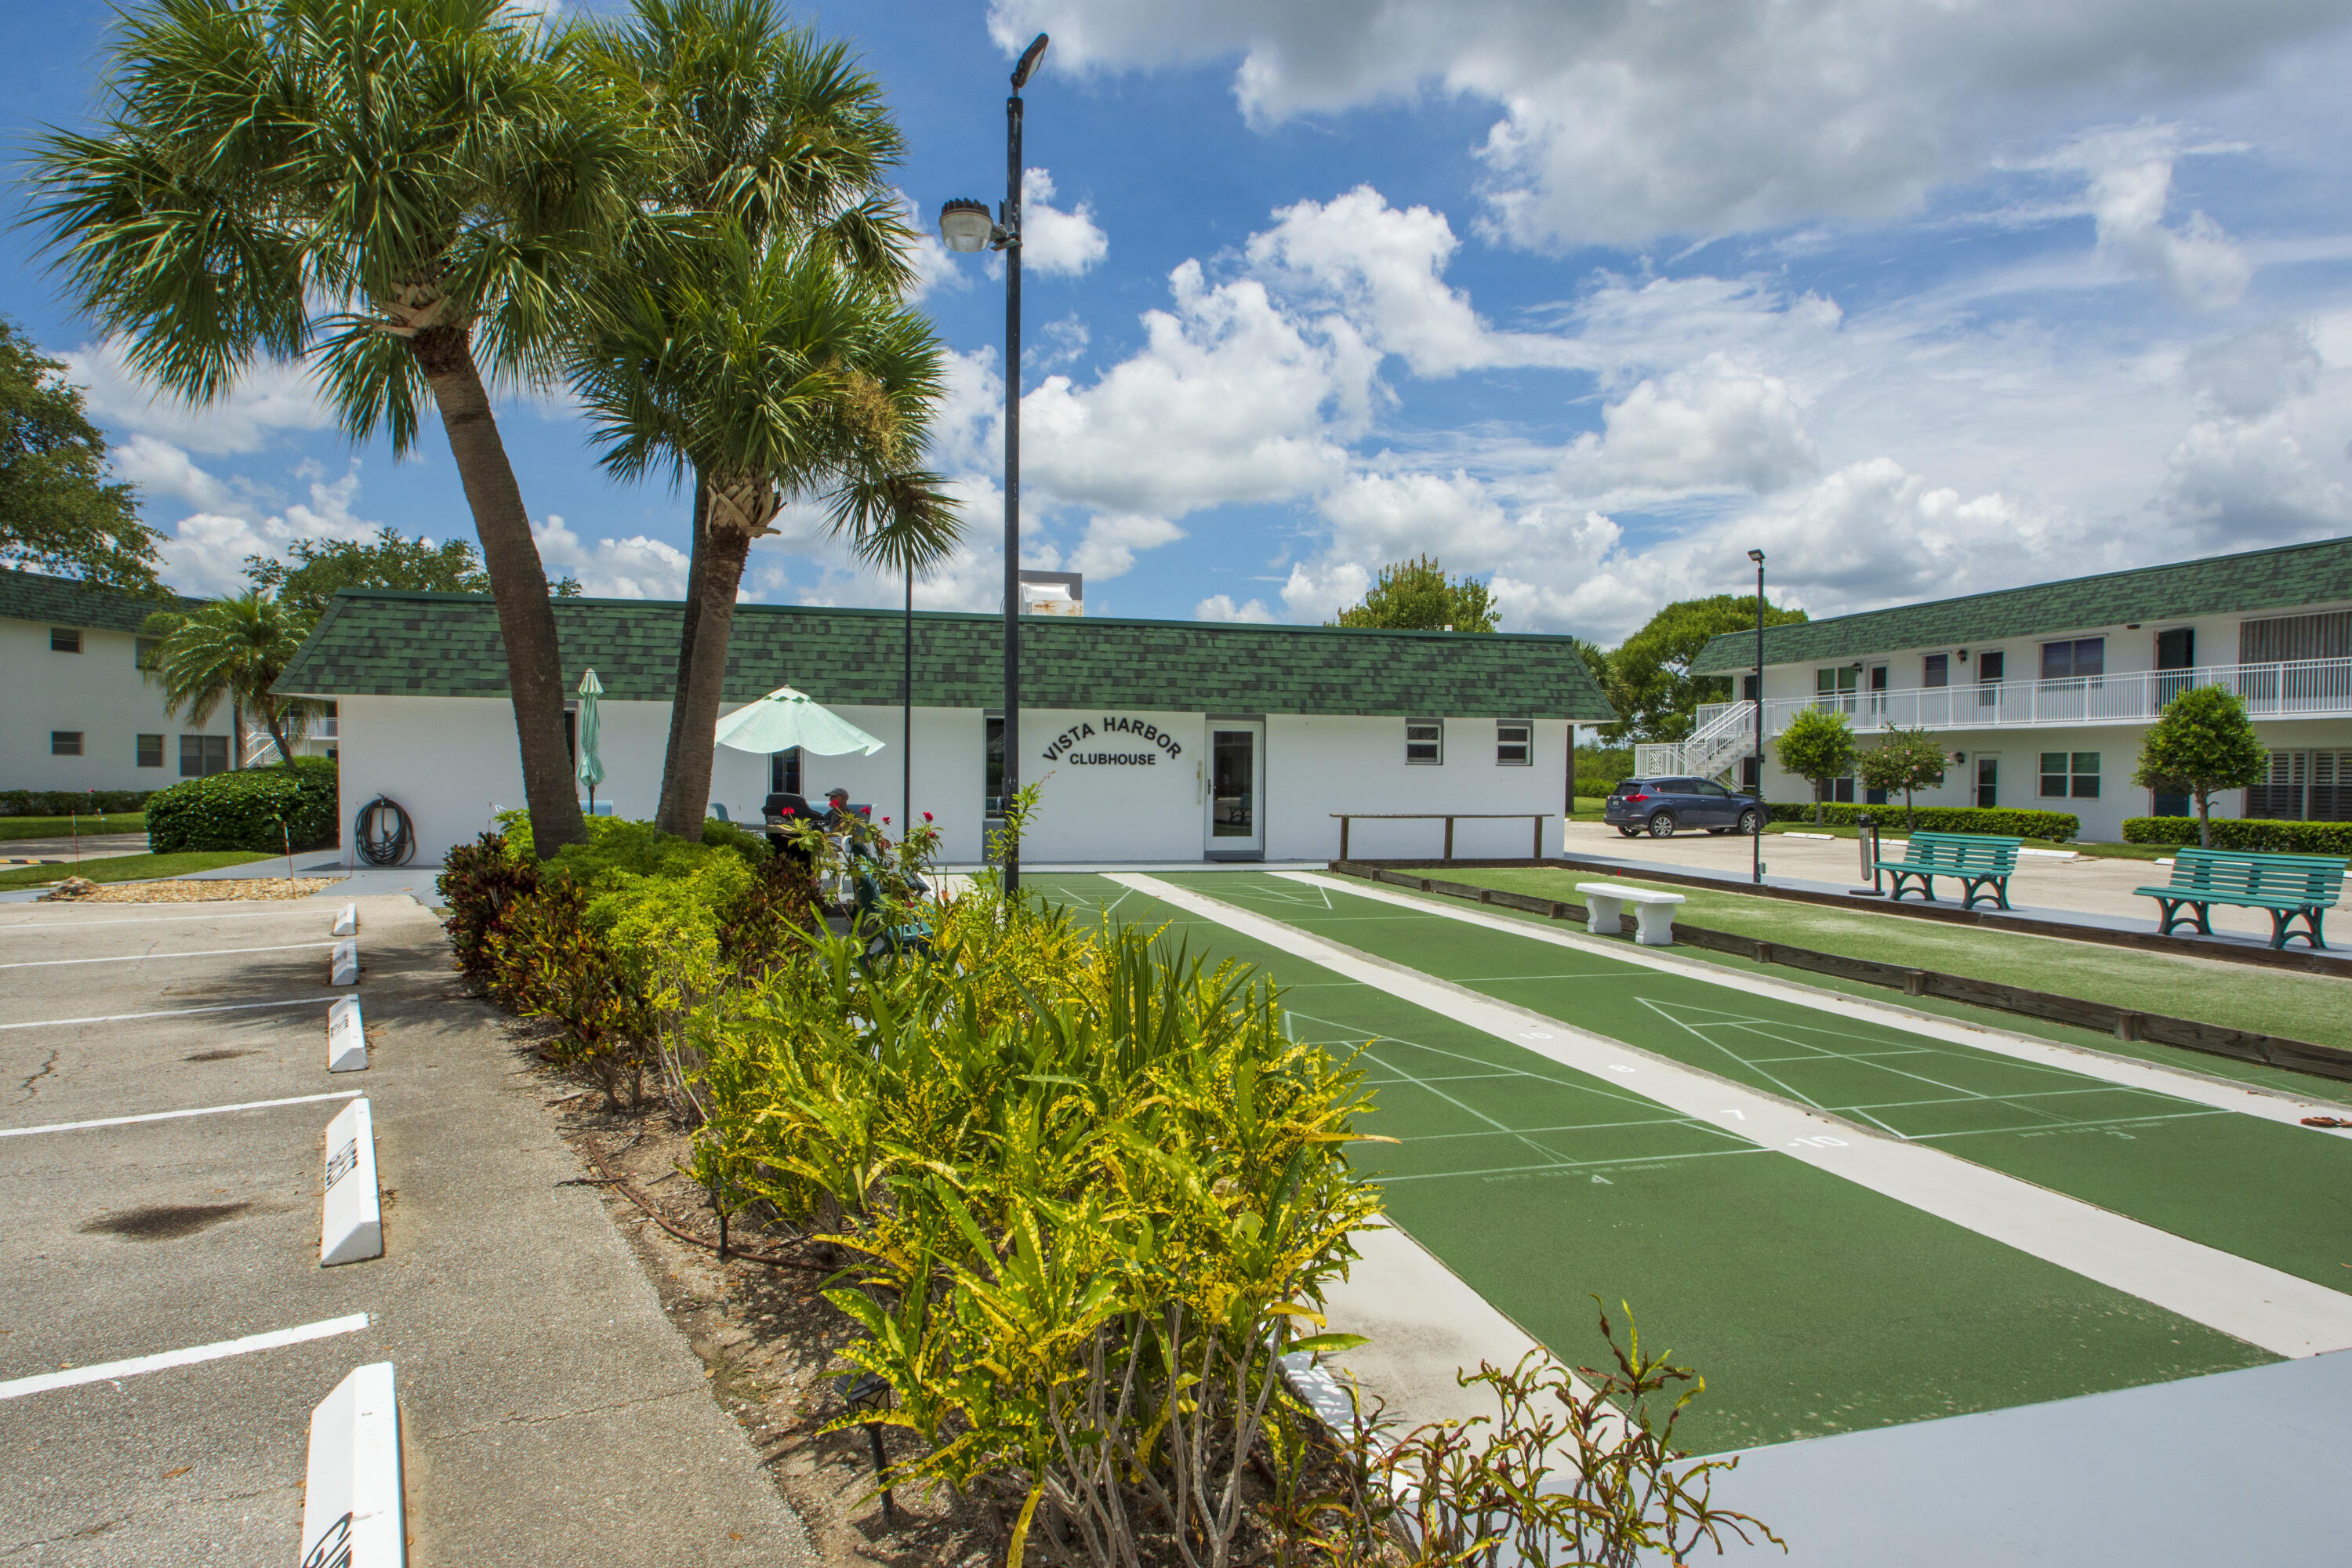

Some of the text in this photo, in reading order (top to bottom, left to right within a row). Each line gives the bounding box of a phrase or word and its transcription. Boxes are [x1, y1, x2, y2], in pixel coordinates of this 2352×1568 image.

[1042, 717, 1181, 762] VISTA HARBOR
[1069, 753, 1156, 765] CLUBHOUSE
[1607, 1064, 1636, 1073] 8
[1719, 1109, 1746, 1120] 7
[2105, 1131, 2137, 1140] 3
[325, 1137, 358, 1193] GUEST
[1591, 1174, 1614, 1185] 4
